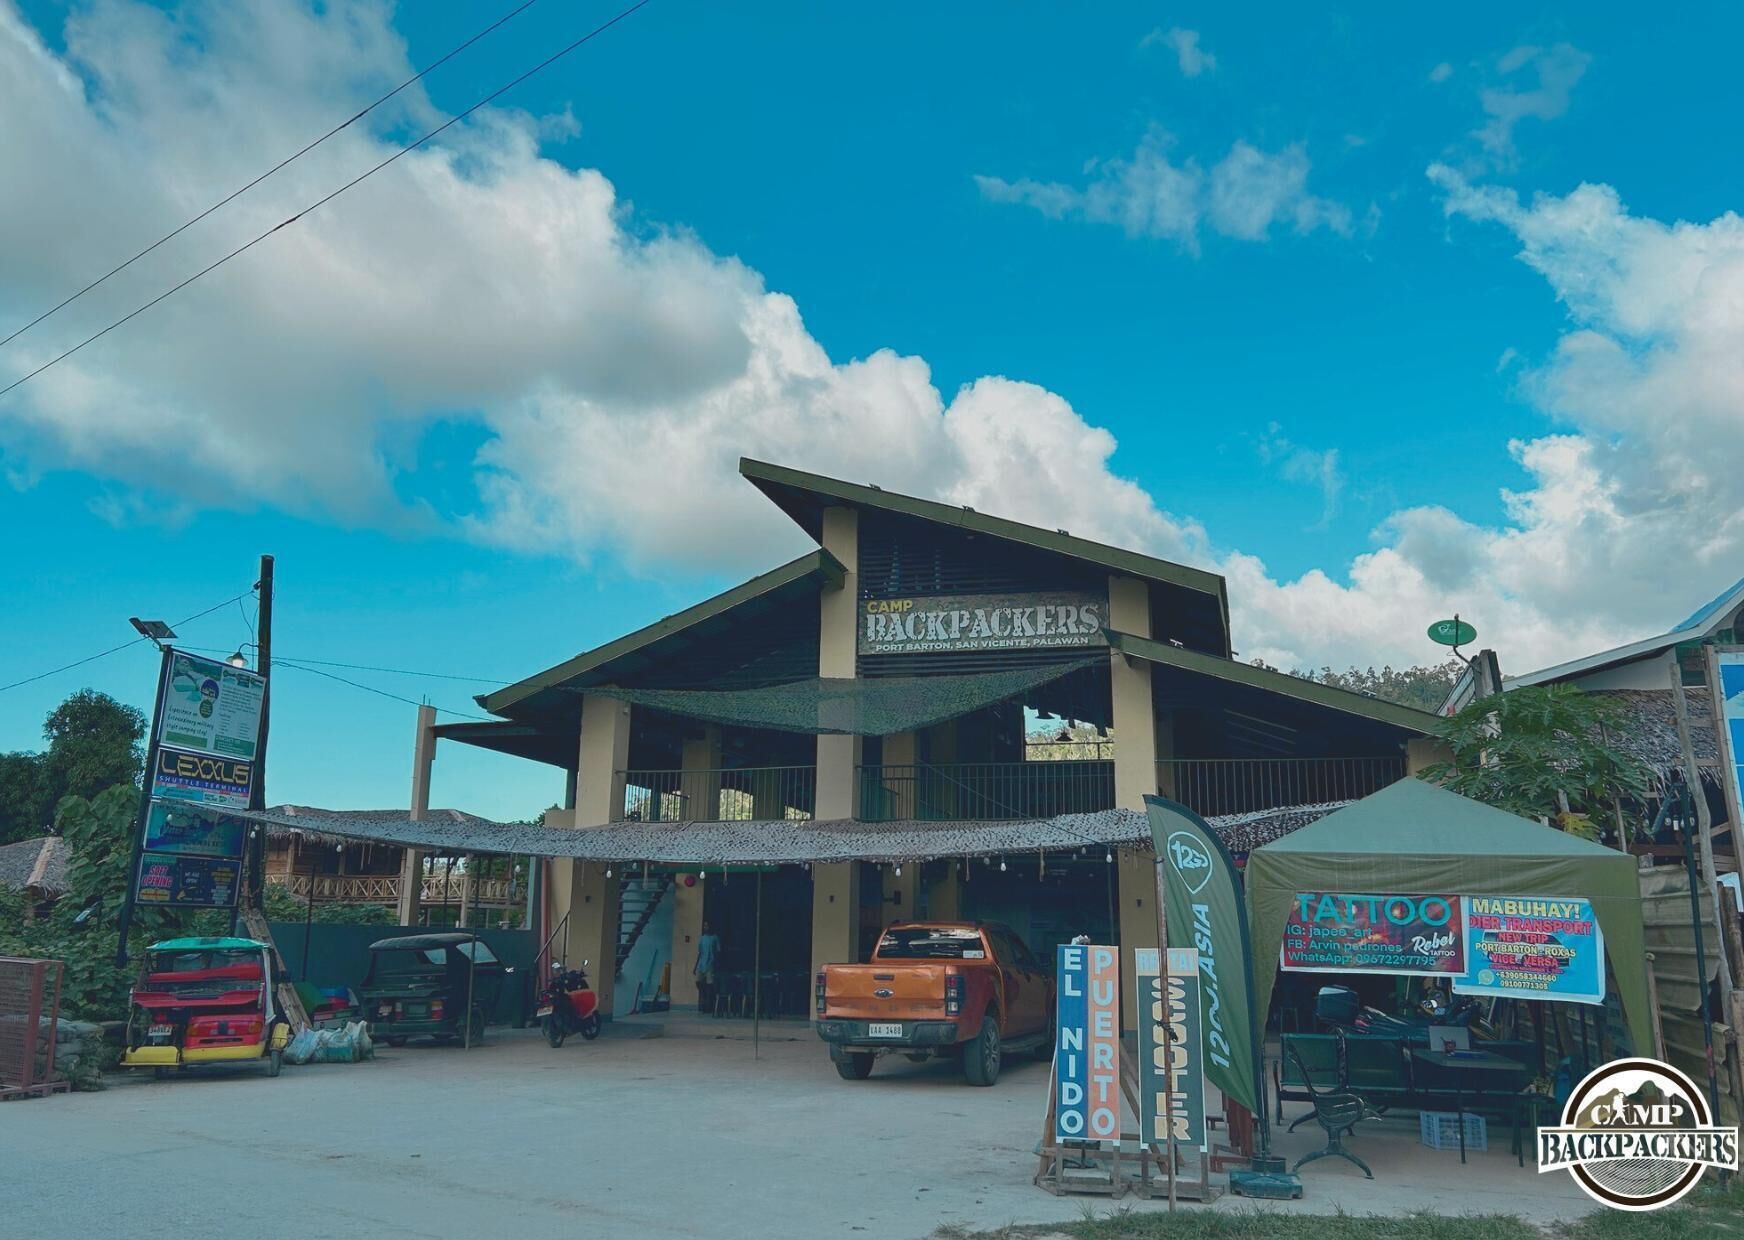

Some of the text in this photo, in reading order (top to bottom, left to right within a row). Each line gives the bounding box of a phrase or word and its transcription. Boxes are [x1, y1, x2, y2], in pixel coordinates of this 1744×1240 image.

[867, 599, 913, 614] CAMP
[866, 604, 1101, 642] BACKPACKERS
[875, 644, 903, 652] PORT
[956, 640, 979, 649] SAN
[1033, 637, 1089, 646] PALAWAN
[161, 751, 250, 784] LEXXUS
[159, 775, 200, 787] SHUTTLE
[205, 781, 247, 793] TERMINAL
[1295, 893, 1452, 927] TATTOO
[1472, 898, 1580, 919] MABUHAY!
[1287, 924, 1306, 936] IG:
[1504, 916, 1593, 936] TRANSPORT
[1287, 939, 1306, 950] FB:
[1309, 939, 1341, 951] Arvin
[1412, 932, 1456, 956] Rebel
[1498, 932, 1549, 944] NEW TRIP
[1475, 943, 1499, 952] PORT
[1501, 944, 1538, 955] BARTON
[1545, 947, 1577, 957] ROXAS
[1523, 955, 1559, 967] VERSA
[1064, 948, 1083, 997] EL
[1091, 950, 1116, 1136] PUERTO
[1151, 977, 1192, 1141] SCOOTER
[1060, 1027, 1084, 1135] NIDO
